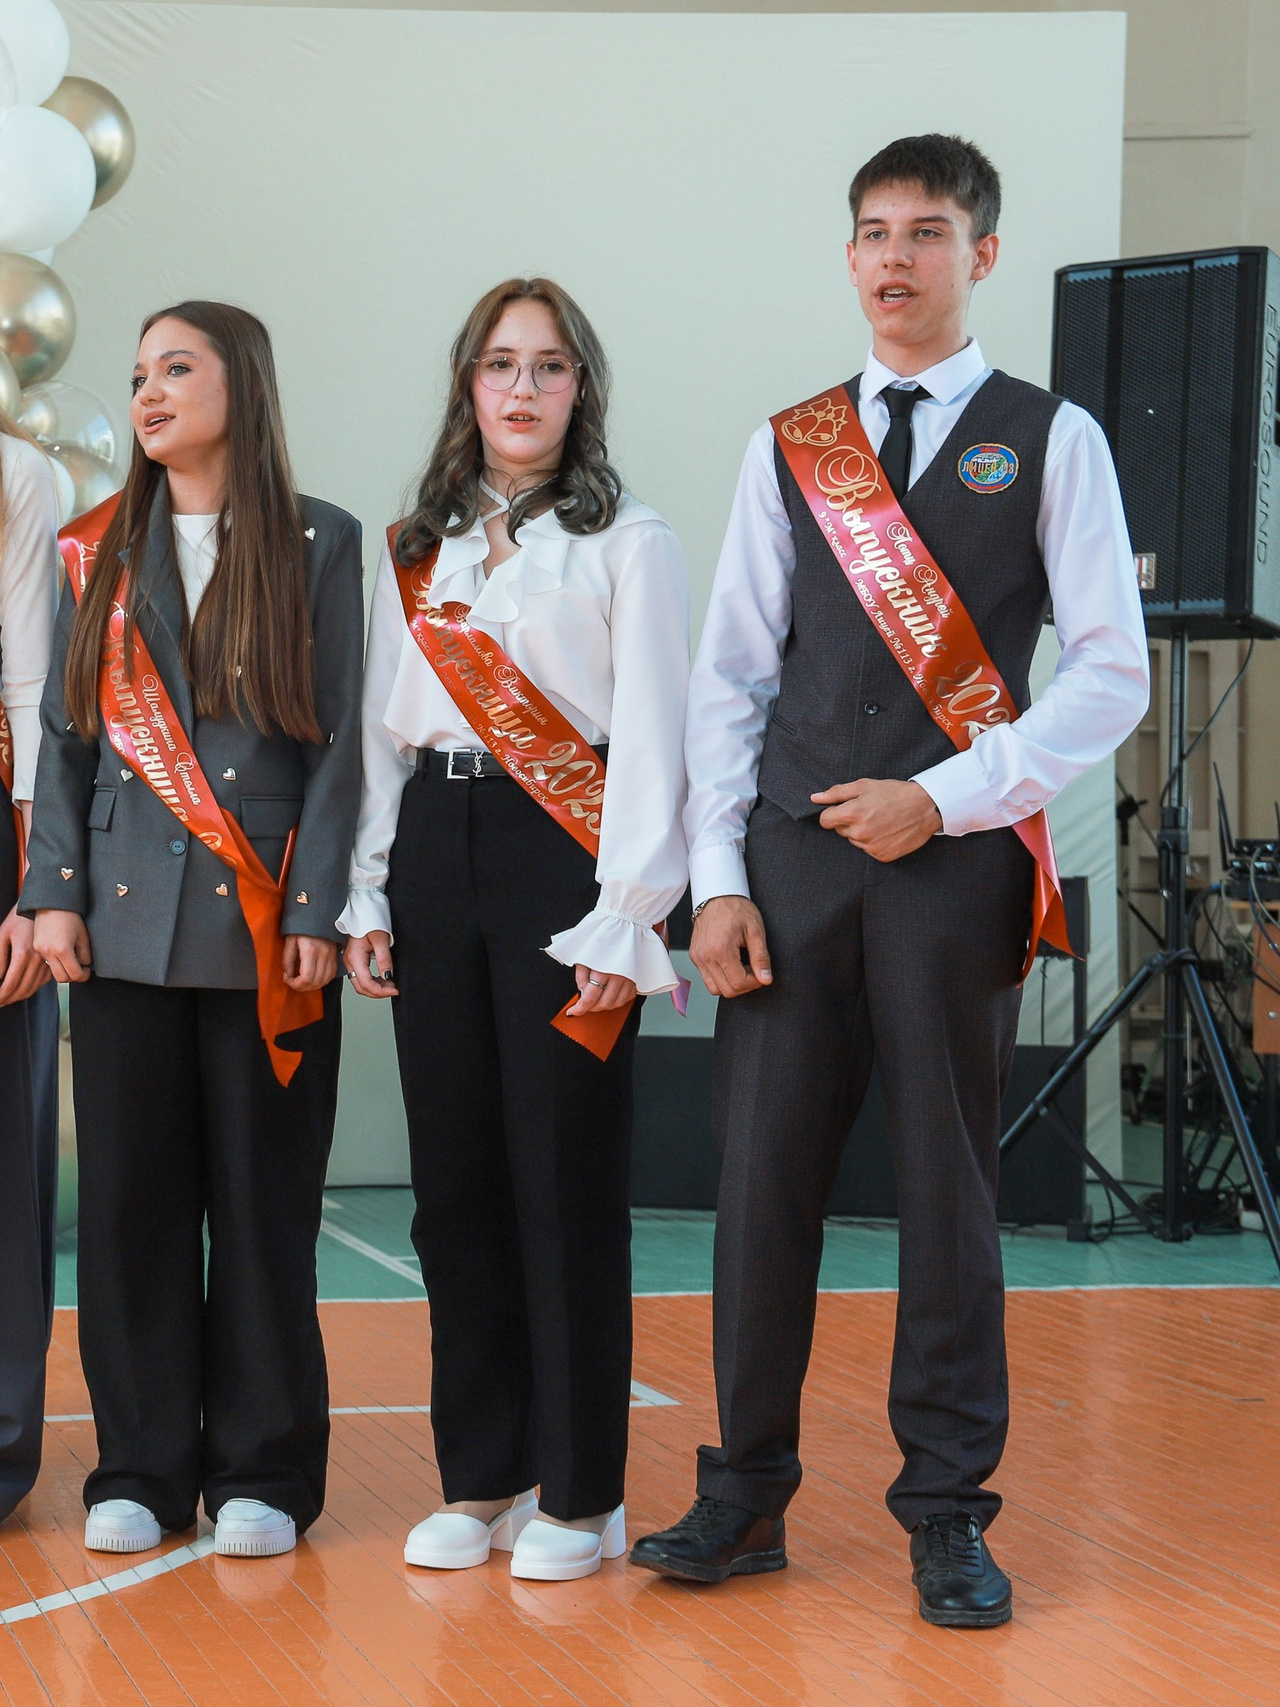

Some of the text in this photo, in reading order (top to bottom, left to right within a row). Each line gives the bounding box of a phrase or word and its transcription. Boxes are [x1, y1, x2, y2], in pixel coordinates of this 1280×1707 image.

[1256, 303, 1277, 565] EUROSOUND
[814, 445, 1011, 741] Выпускник 202
[913, 564, 954, 619] Андрей
[831, 535, 847, 558] класс
[854, 578, 880, 608] МБОУ
[871, 610, 896, 639] Лицей
[890, 637, 914, 665] №113
[912, 673, 955, 732] Новбирск
[493, 664, 548, 726] Виктория
[174, 751, 201, 806] Стелла
[501, 753, 549, 806] Новосибирск
